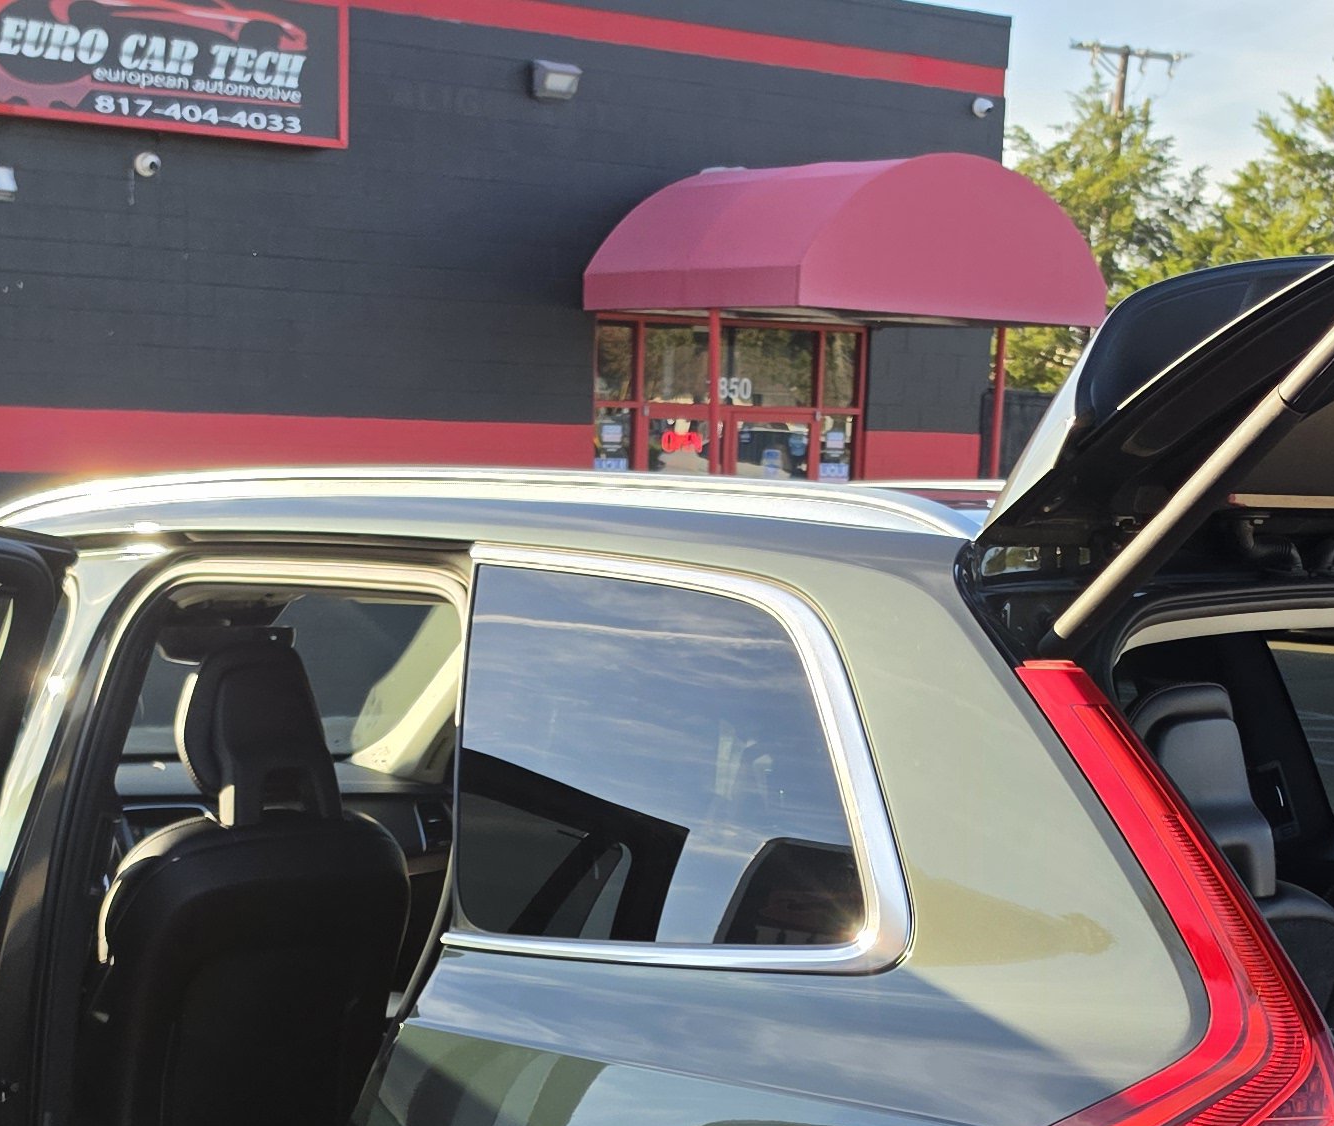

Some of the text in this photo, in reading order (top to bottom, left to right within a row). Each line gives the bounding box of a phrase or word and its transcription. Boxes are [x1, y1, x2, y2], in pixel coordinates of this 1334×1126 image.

[119, 33, 199, 76] CAR
[209, 44, 307, 89] TECH
[93, 67, 302, 103] european automotive
[94, 94, 302, 134] 817-404-4033
[706, 377, 752, 400] 850
